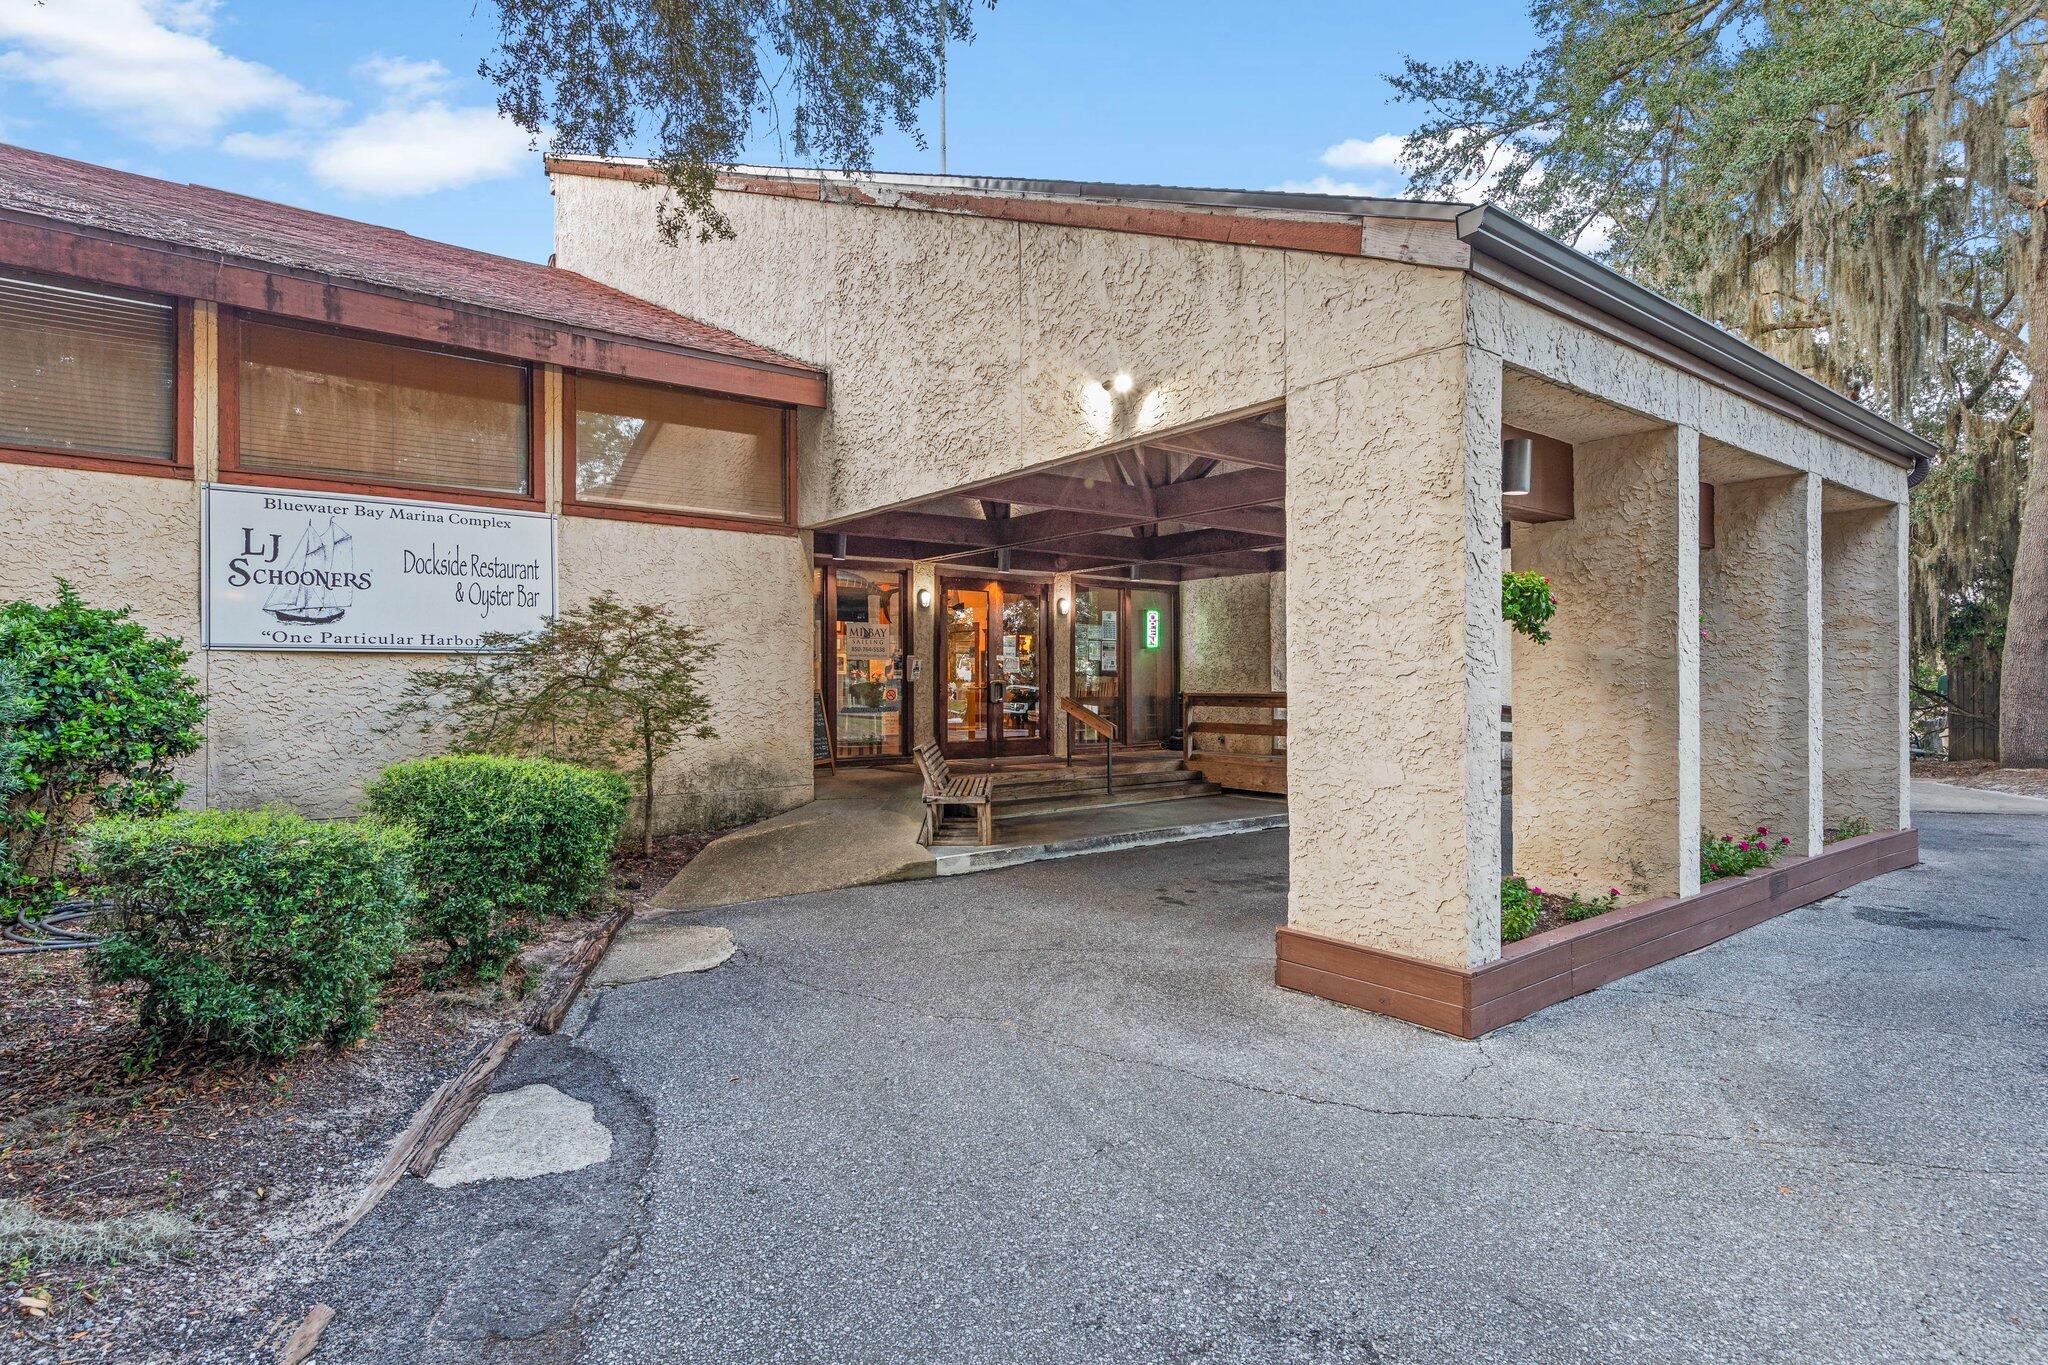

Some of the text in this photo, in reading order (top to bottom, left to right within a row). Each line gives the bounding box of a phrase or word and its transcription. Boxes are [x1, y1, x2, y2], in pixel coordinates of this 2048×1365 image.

[263, 497, 512, 529] Bluewater Bay Marina Complex
[240, 527, 282, 563] LJ
[403, 542, 540, 580] Dockside Restaurant
[455, 581, 540, 619] & Oyster Bar
[320, 632, 414, 645] Particular
